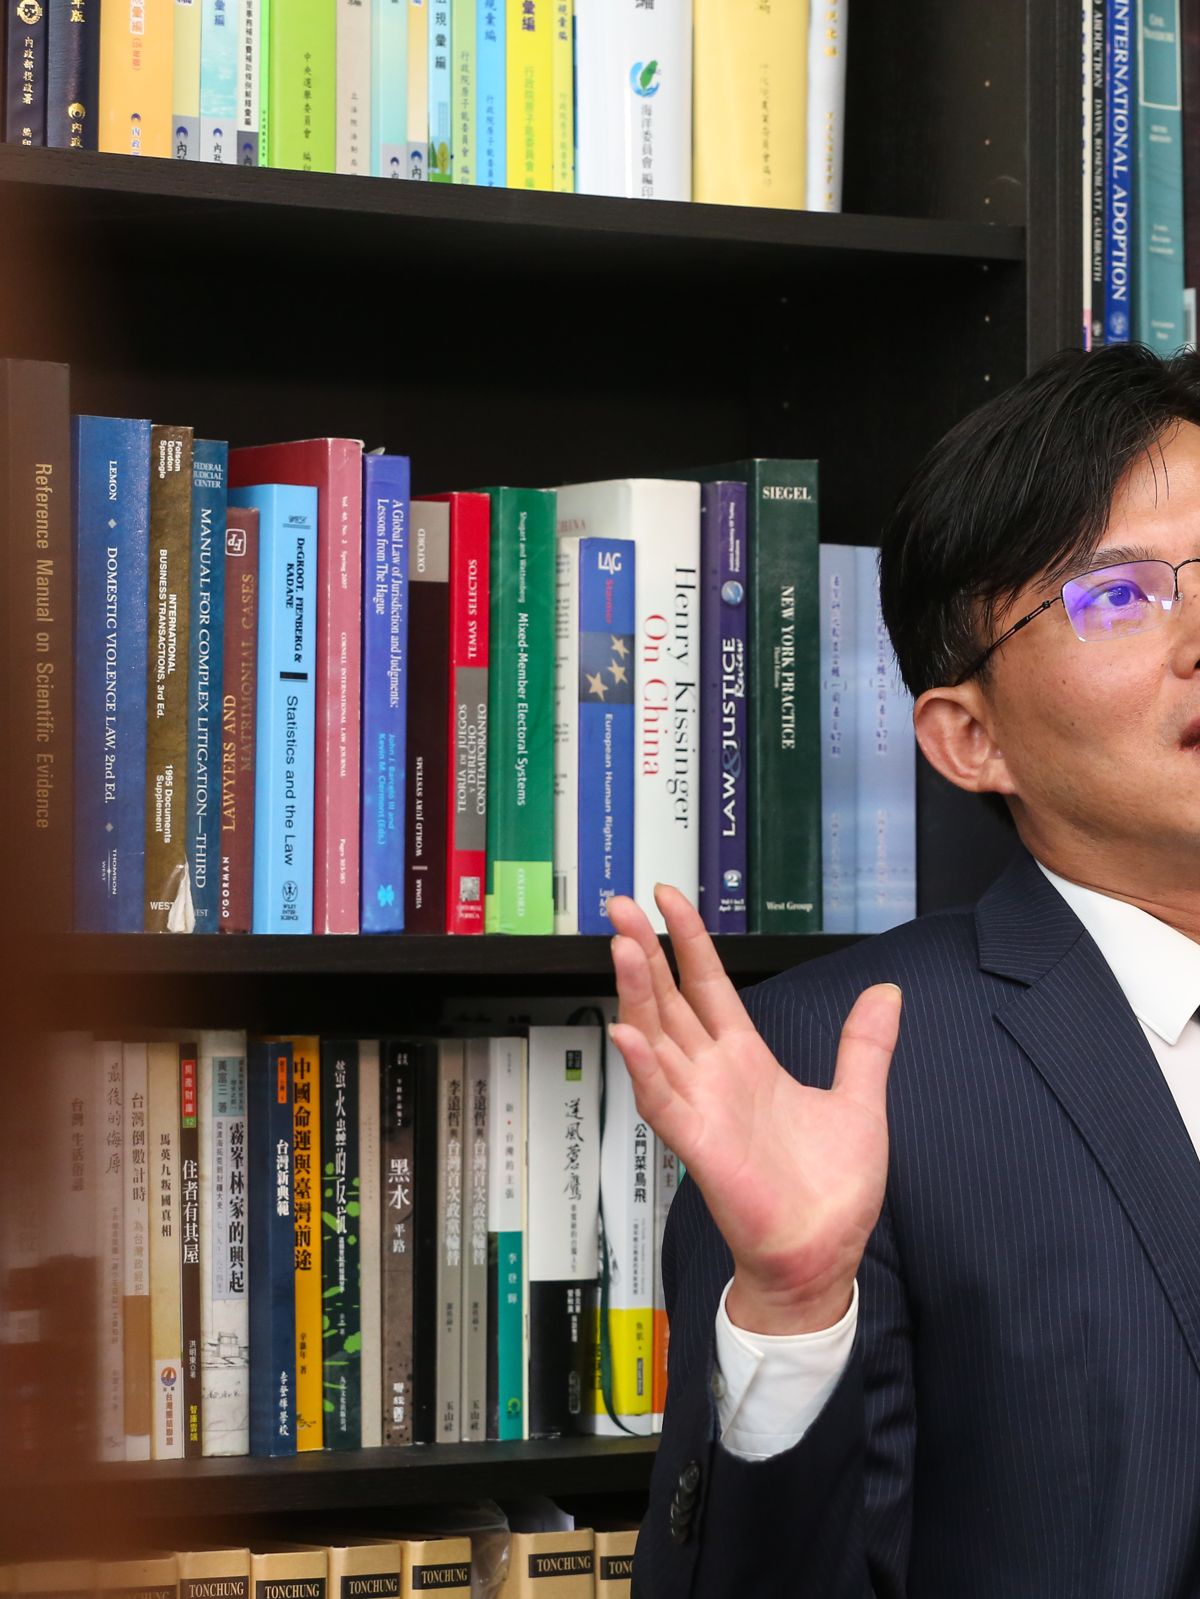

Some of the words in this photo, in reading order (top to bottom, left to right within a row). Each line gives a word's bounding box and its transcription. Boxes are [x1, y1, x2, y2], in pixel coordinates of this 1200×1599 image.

[22, 36, 35, 105] 內政部役政署
[1093, 12, 1103, 88] ABDUCTION
[303, 52, 312, 139] 中央選舉委員會
[1112, 0, 1131, 180] INTERNATIONAL
[641, 104, 653, 170] 海洋委員會
[1111, 184, 1130, 301] ADOPTION
[108, 460, 118, 500] LEMON
[158, 440, 168, 479] Spanogle
[167, 441, 175, 472] Gordon
[35, 463, 52, 549] Reference
[194, 479, 221, 488] CENTER
[762, 485, 812, 501] SIEGEL
[377, 499, 388, 536] Lessons
[392, 510, 403, 541] Global
[200, 507, 213, 588] MANUAL
[376, 539, 388, 561] from
[376, 563, 387, 581] The
[392, 543, 403, 564] Law
[417, 528, 426, 573] OXFORD
[36, 560, 53, 621] Manual
[106, 546, 118, 629] DOMESTIC
[159, 549, 168, 599] BUSINESS
[286, 562, 295, 609] KADANE
[373, 584, 387, 615] Hague
[467, 560, 478, 616] SELECTOS
[199, 591, 212, 625] FOR
[240, 574, 253, 630] CASES
[294, 597, 304, 649] FIENBERG
[391, 579, 403, 632] Jurisdiction
[667, 567, 697, 665] Henry
[781, 585, 796, 620] NEW
[37, 632, 50, 652] on
[158, 600, 167, 682] TRANSACTIONS,
[168, 594, 177, 674] INTERNATIONAL
[390, 635, 402, 652] and
[467, 621, 478, 660] TEMAS
[517, 612, 529, 699] Mixed-Member
[643, 614, 663, 664] On
[781, 624, 796, 669] YORK
[105, 633, 118, 712] VIOLENCE
[158, 684, 166, 700] 3rd
[197, 628, 211, 713] COMPLEX
[388, 654, 401, 708] Judgments:
[722, 638, 736, 750] JUSTICE
[36, 662, 54, 743] Scientific
[223, 696, 236, 733] AND
[240, 642, 253, 772] MATRIMONIAL
[517, 702, 528, 754] Electoral
[642, 678, 668, 776] China
[781, 672, 796, 749] PRACTICE
[104, 716, 117, 752] LAW,
[286, 695, 299, 764] Statistics
[456, 705, 467, 754] JUEGOS
[467, 725, 477, 784] DERECHO
[604, 713, 614, 768] European
[665, 681, 697, 830] Kissinger
[36, 754, 53, 828] Evidence
[104, 755, 117, 779] 2nd
[104, 783, 117, 803] Ed.
[165, 764, 173, 787] 1995
[223, 743, 236, 831] LAWYERS
[285, 770, 297, 799] and
[515, 757, 528, 806] Systems
[605, 771, 614, 811] Human
[155, 774, 165, 833] Supplement
[163, 789, 172, 844] Documents
[284, 804, 296, 828] the
[722, 772, 736, 837] LAW
[283, 834, 296, 866] Law
[604, 815, 613, 852] Rights
[222, 857, 230, 918] O'GORMAN
[605, 855, 613, 878] Law
[786, 901, 814, 913] Group
[217, 1059, 228, 1096] 黃富三
[131, 1092, 146, 1203] 台灣倒數計時
[294, 1056, 312, 1272] 中國命運與臺灣前途
[334, 1060, 348, 1235] 螢火蟲的反抗
[633, 1123, 648, 1204] 公門菜鳥飛
[159, 1132, 172, 1237] 馬英九叛國真相
[276, 1138, 290, 1217] 台灣新典範
[387, 1157, 411, 1210] 黑水
[183, 1159, 200, 1264] 住者有其屋
[393, 1222, 406, 1253] 平路
[507, 1252, 518, 1304] 李登輝
[278, 1370, 290, 1436] 李登輝學校
[189, 1582, 244, 1599] TONCHUNG
[349, 1578, 398, 1595] TONCHUNG
[421, 1568, 468, 1584] TONCHUNG
[536, 1557, 590, 1573] TONCHUNG
[265, 1584, 320, 1599] TONCHUNG
